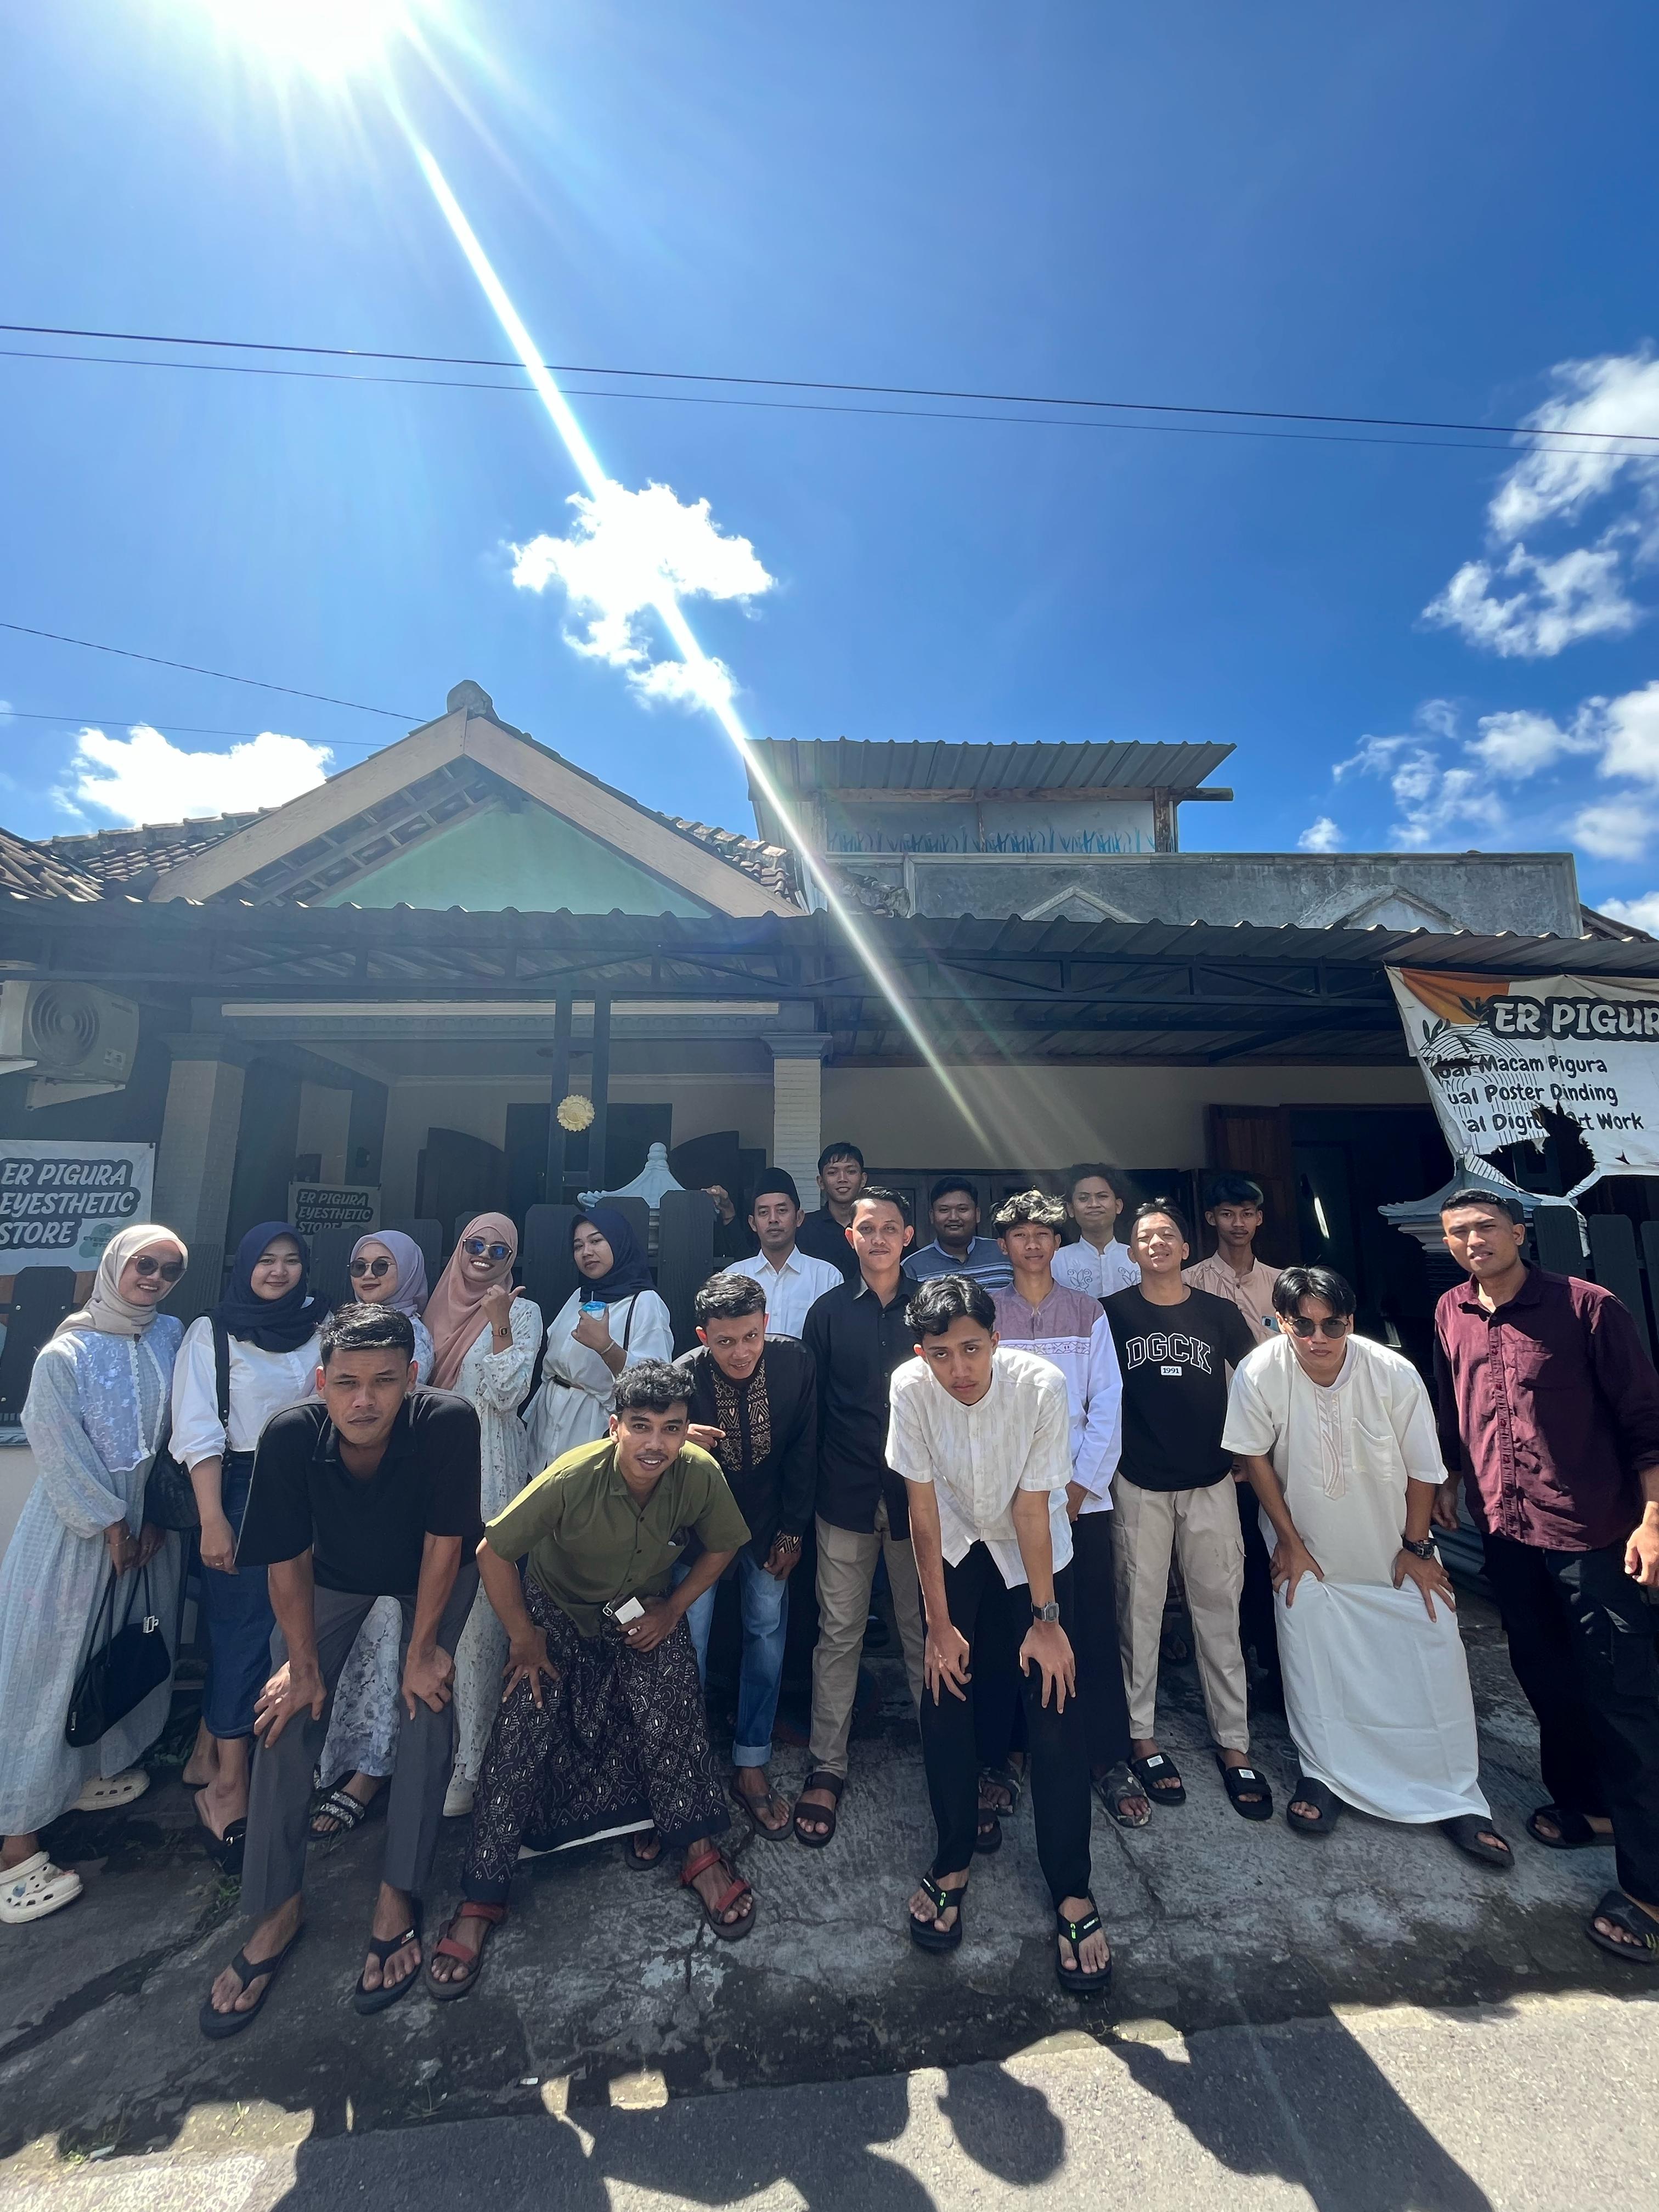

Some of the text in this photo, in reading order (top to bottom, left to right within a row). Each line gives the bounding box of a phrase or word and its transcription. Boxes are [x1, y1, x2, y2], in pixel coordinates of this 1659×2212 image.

[1493, 1003, 1541, 1033] ER
[1479, 1054, 1544, 1074] Macam
[1548, 1055, 1608, 1079] Pigura
[1448, 1083, 1618, 1106] ual Poster Dinding
[1596, 1112, 1644, 1130] Work
[1, 1163, 127, 1186] ER PIGURA
[0, 1192, 134, 1218] EYESTHETIC
[299, 1191, 366, 1206] ER PIGURA
[298, 1206, 371, 1221] EYESTHETIC
[0, 1221, 75, 1245] STORE
[1126, 1332, 1212, 1375] DGCK
